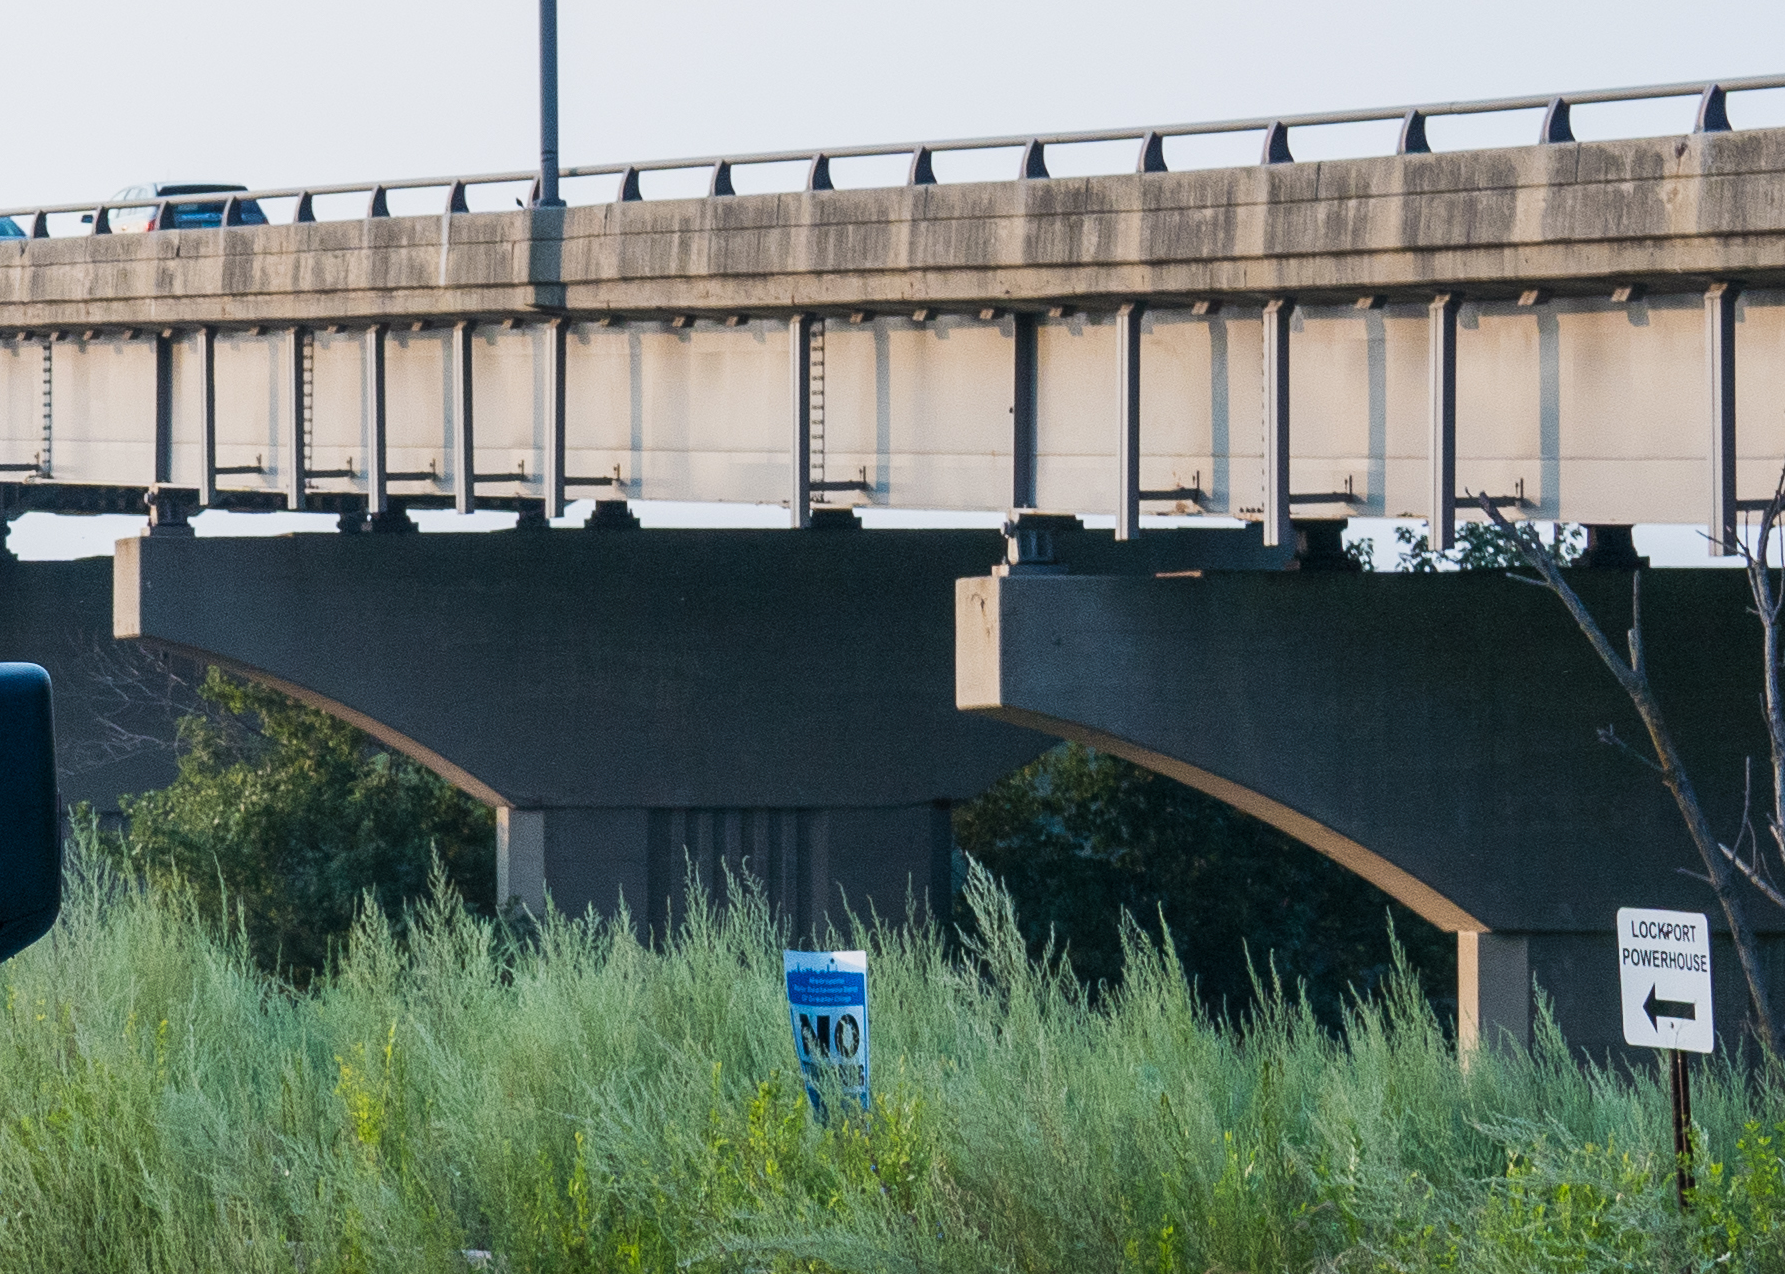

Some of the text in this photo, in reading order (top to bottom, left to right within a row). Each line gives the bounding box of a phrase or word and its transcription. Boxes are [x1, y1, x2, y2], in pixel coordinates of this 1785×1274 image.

[1631, 920, 1697, 943] LOCKPORT
[1622, 947, 1709, 973] POWERHOUSE
[799, 1012, 861, 1059] NO
